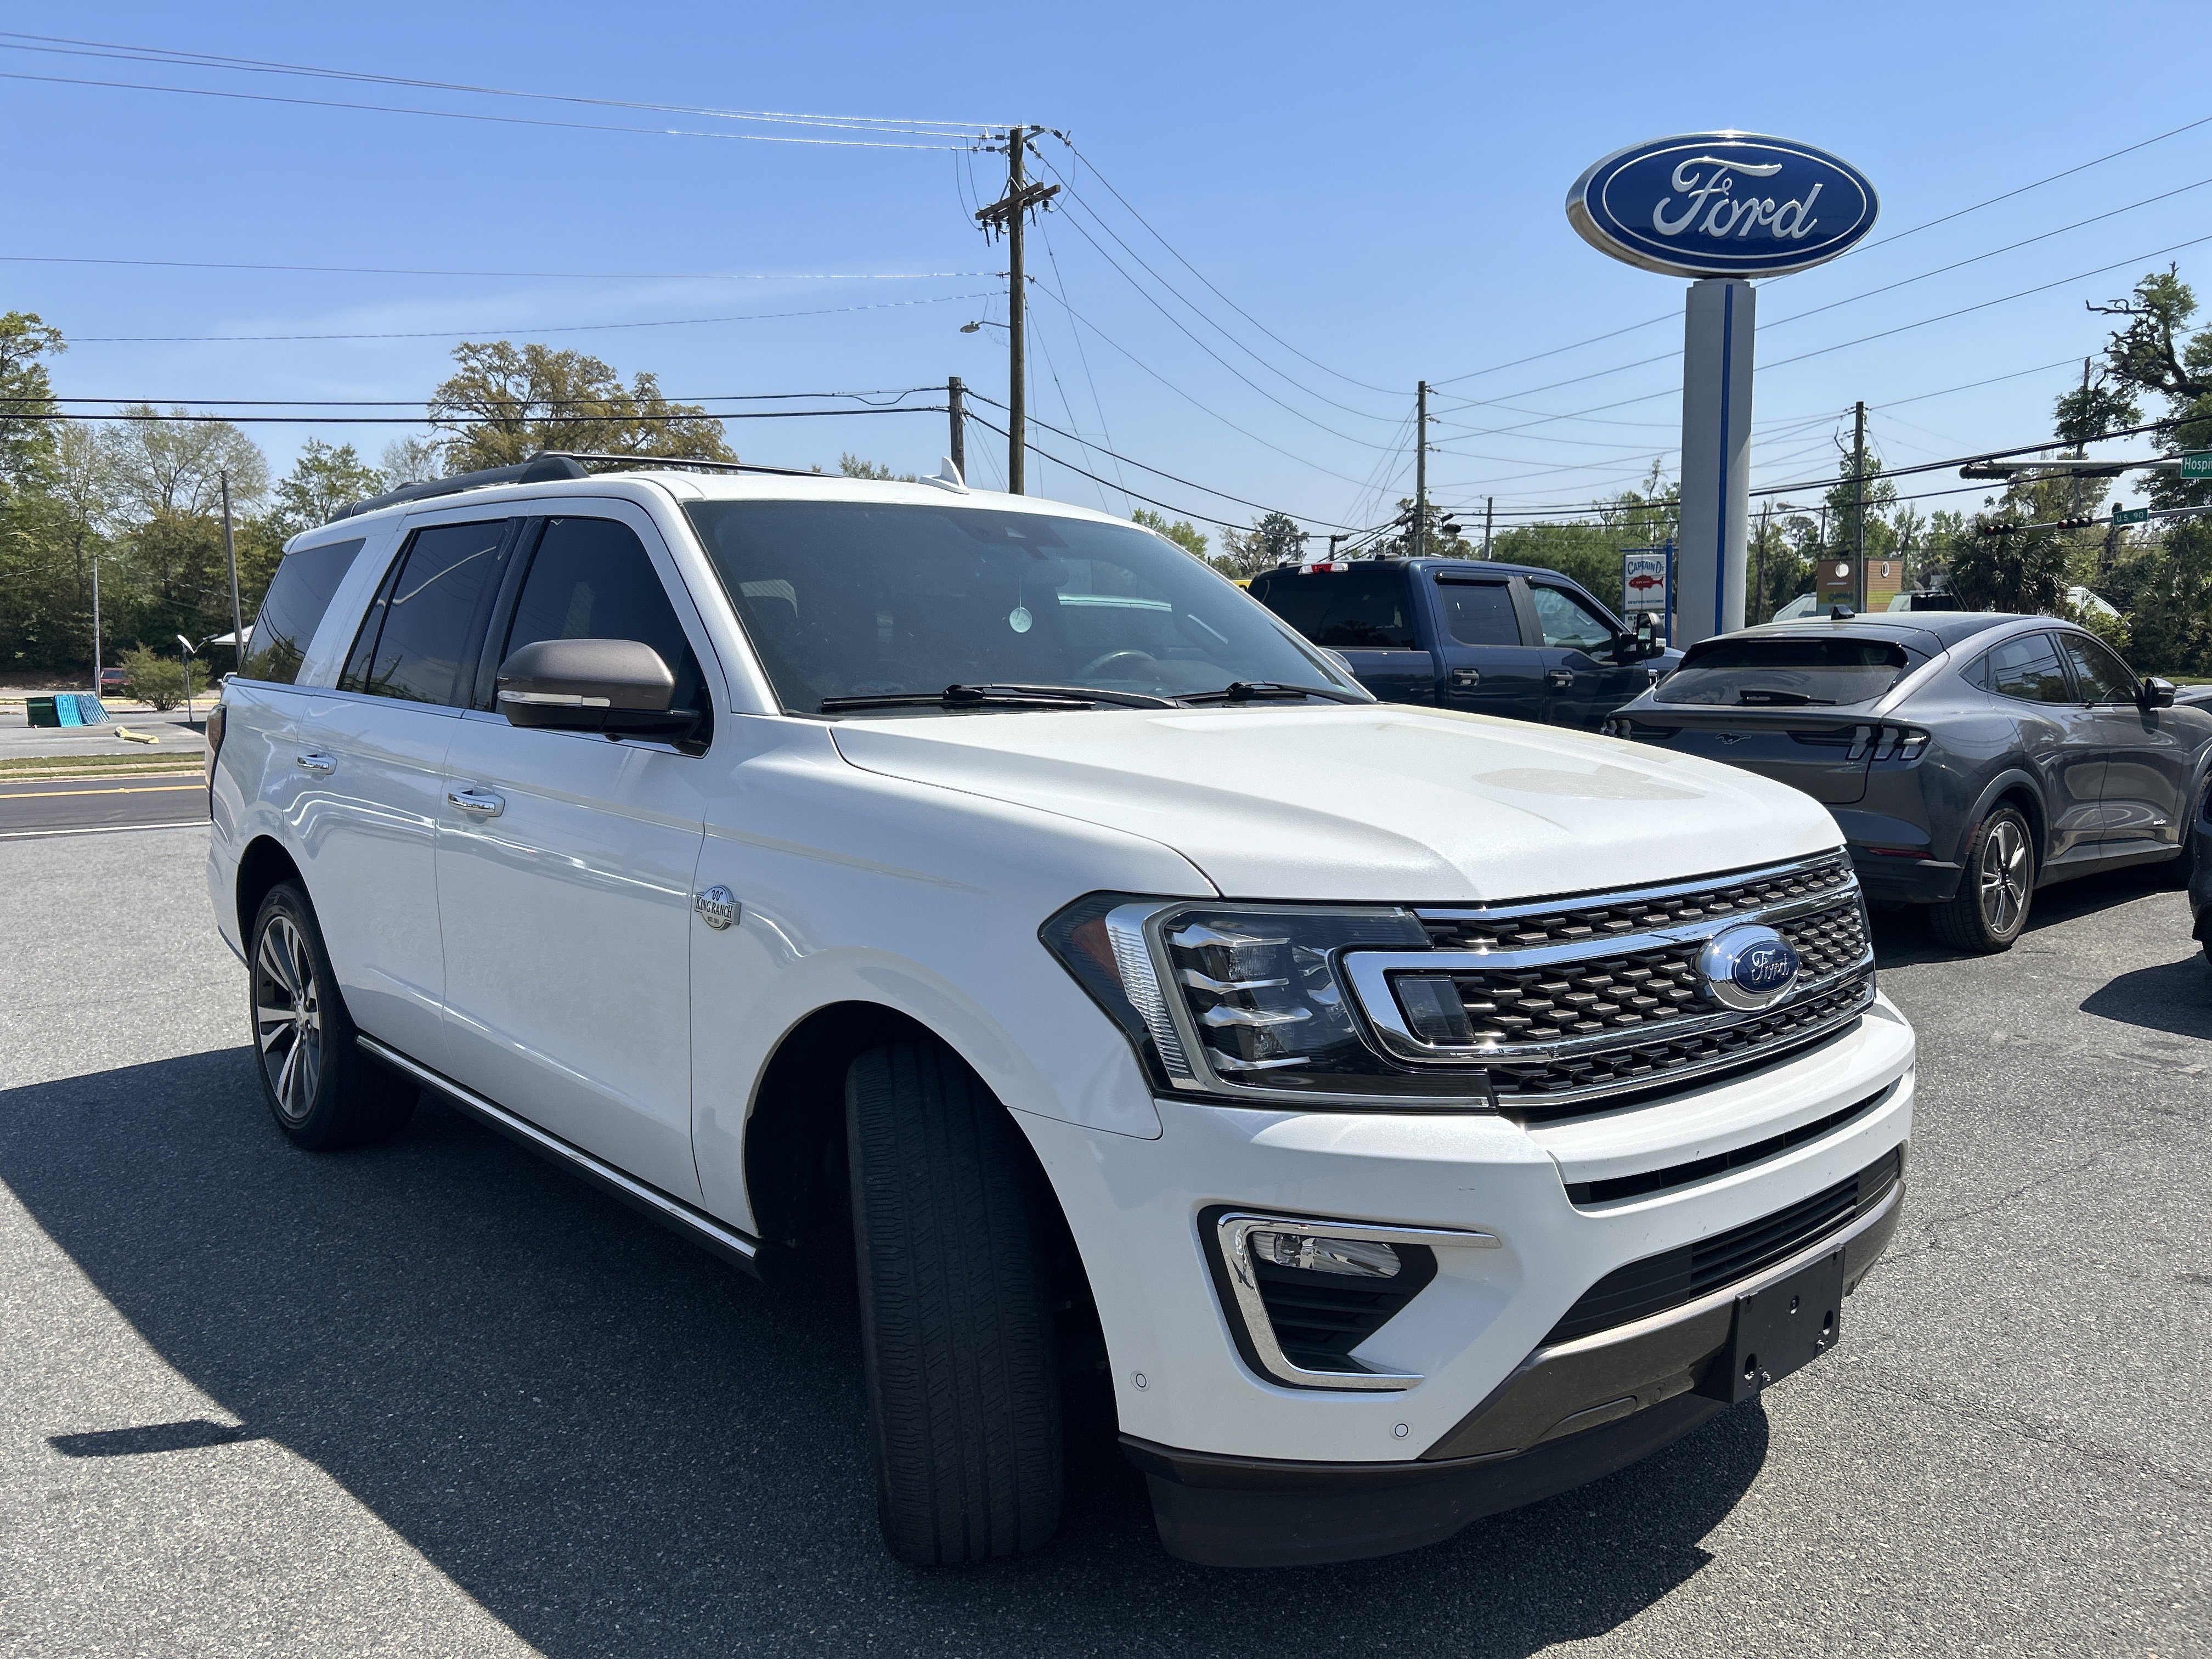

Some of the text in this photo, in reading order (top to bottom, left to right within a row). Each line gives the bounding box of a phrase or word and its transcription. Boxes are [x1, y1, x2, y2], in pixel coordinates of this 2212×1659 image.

[1652, 156, 1823, 239] Ford
[2184, 457, 2212, 472] Hospi
[696, 896, 733, 919] KING RANCH
[1752, 949, 1790, 985] Ford
